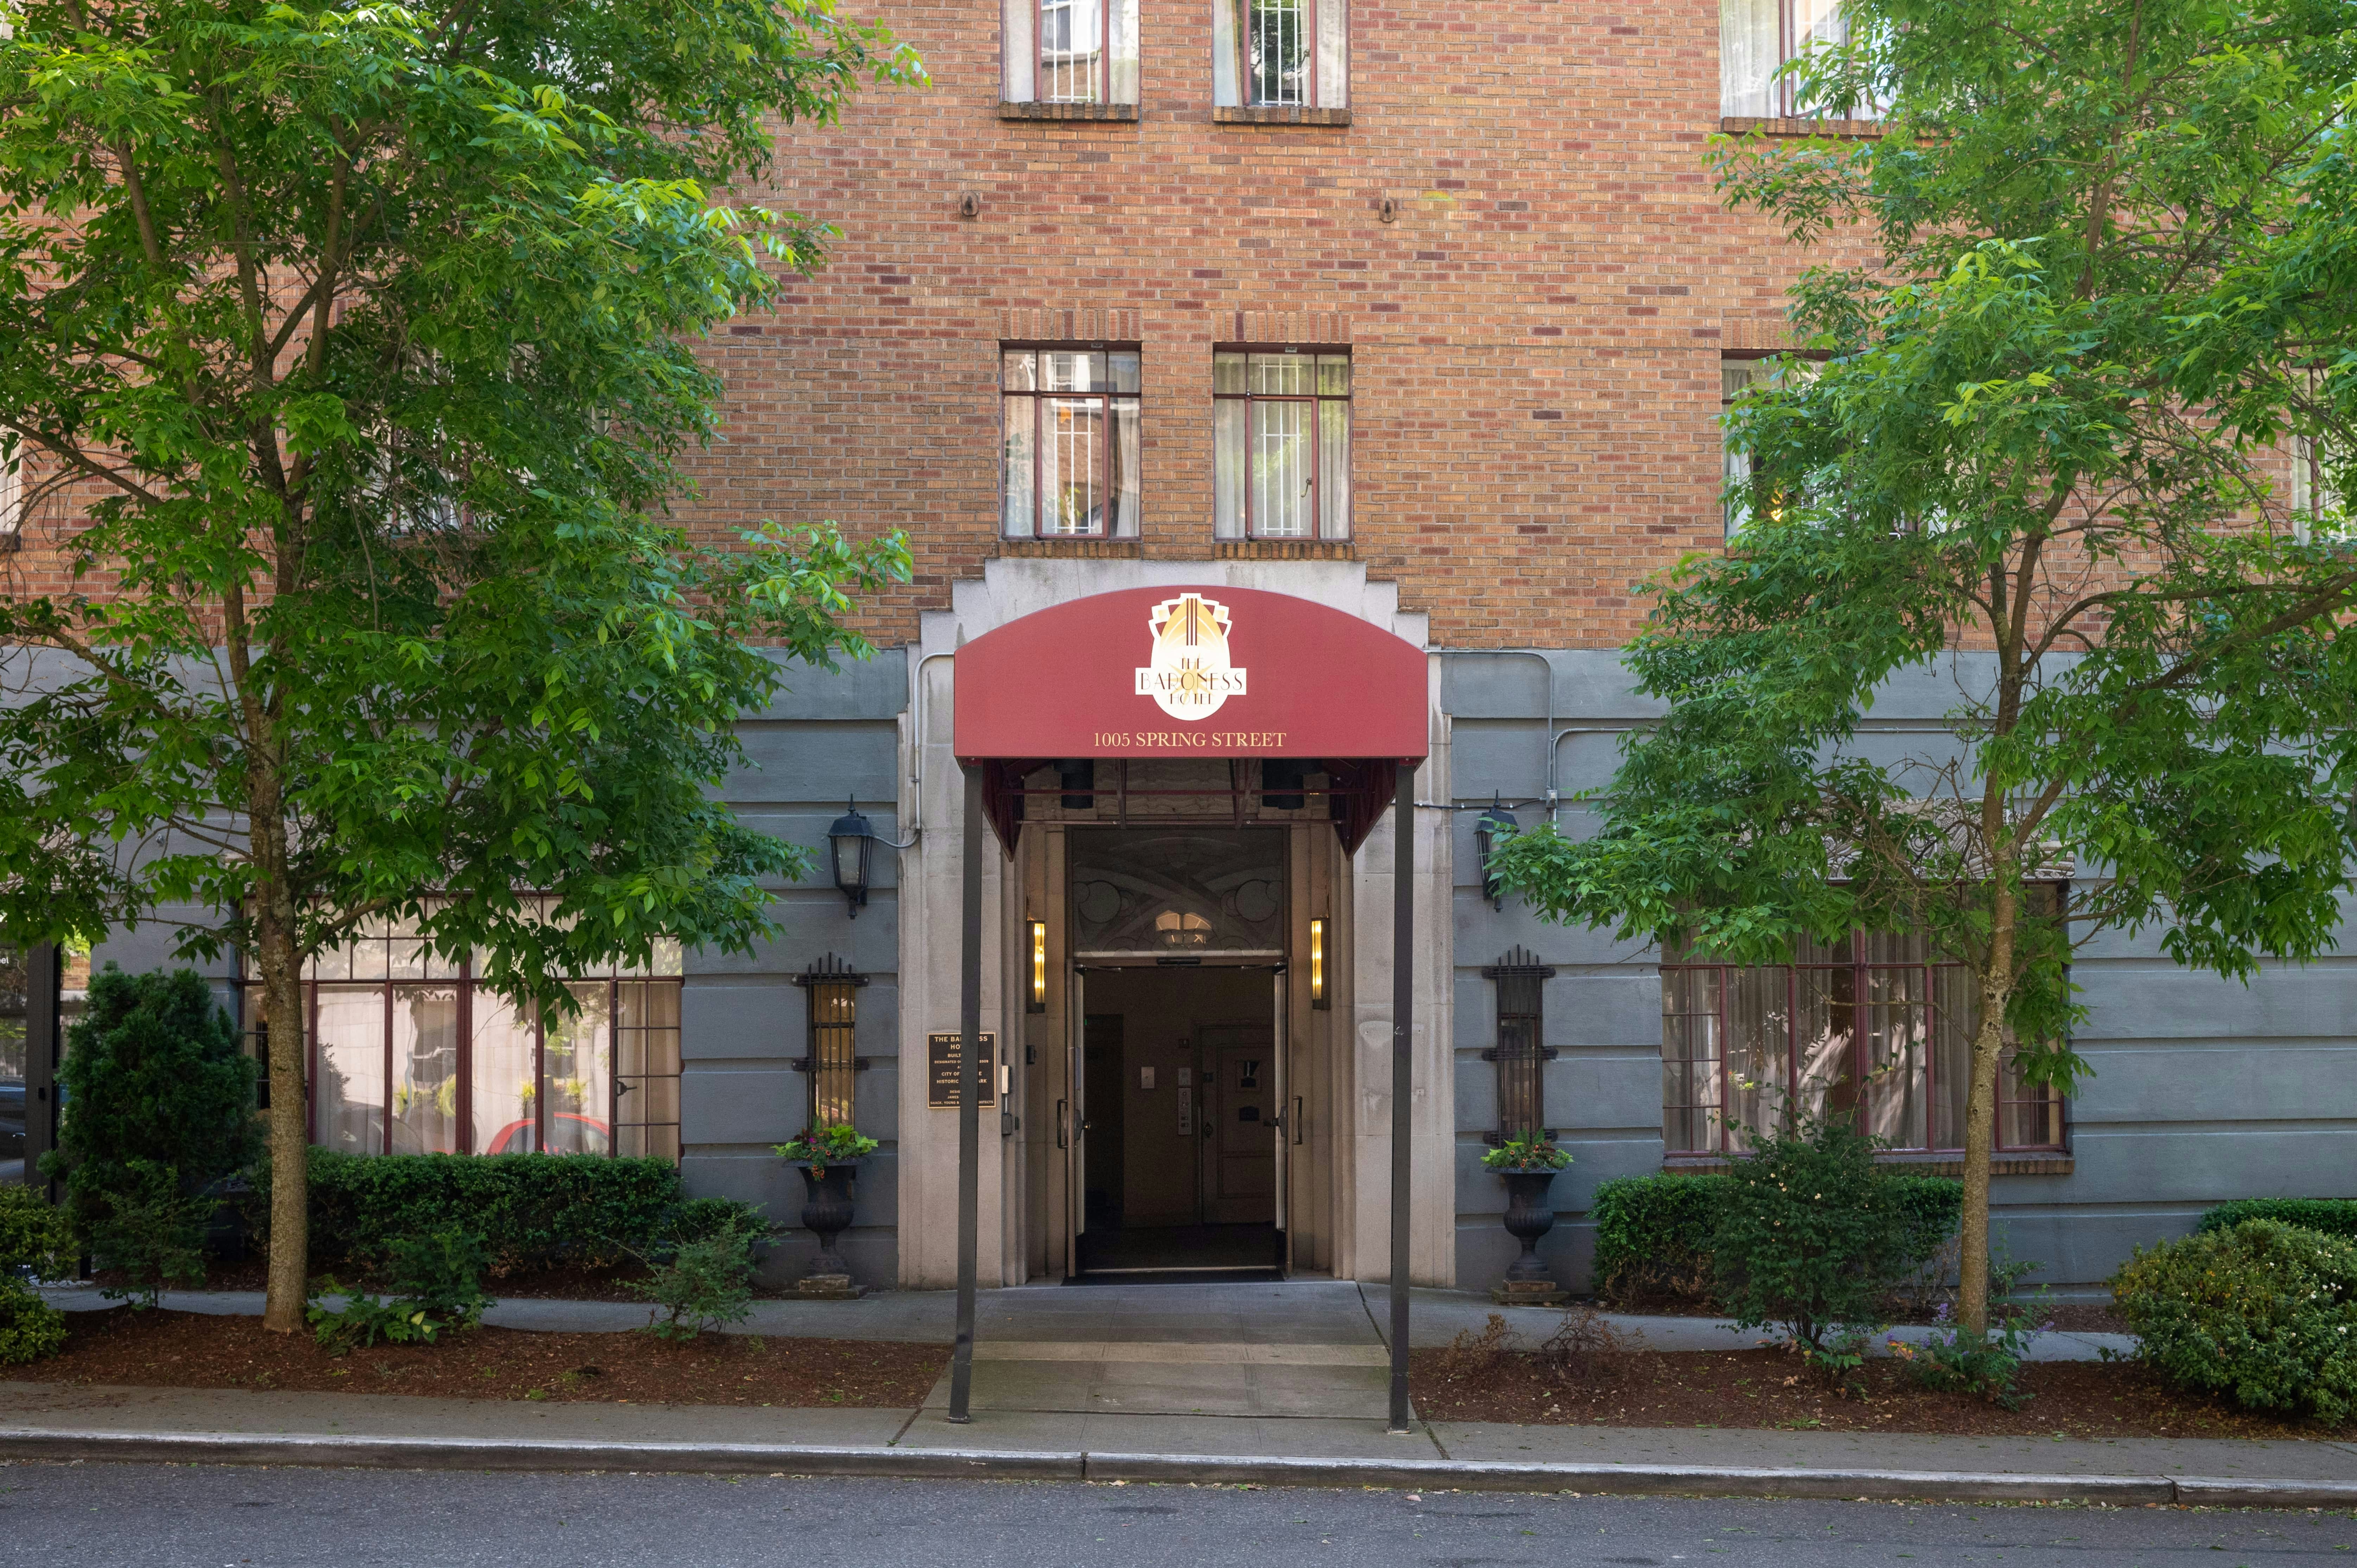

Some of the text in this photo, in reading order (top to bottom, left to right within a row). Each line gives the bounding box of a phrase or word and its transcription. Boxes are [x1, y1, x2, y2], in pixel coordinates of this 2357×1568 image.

[1180, 658, 1204, 669] THE
[1141, 672, 1242, 690] BARONESS
[1170, 693, 1214, 704] HOTEL
[1094, 732, 1286, 747] 1005 SPRING STREET
